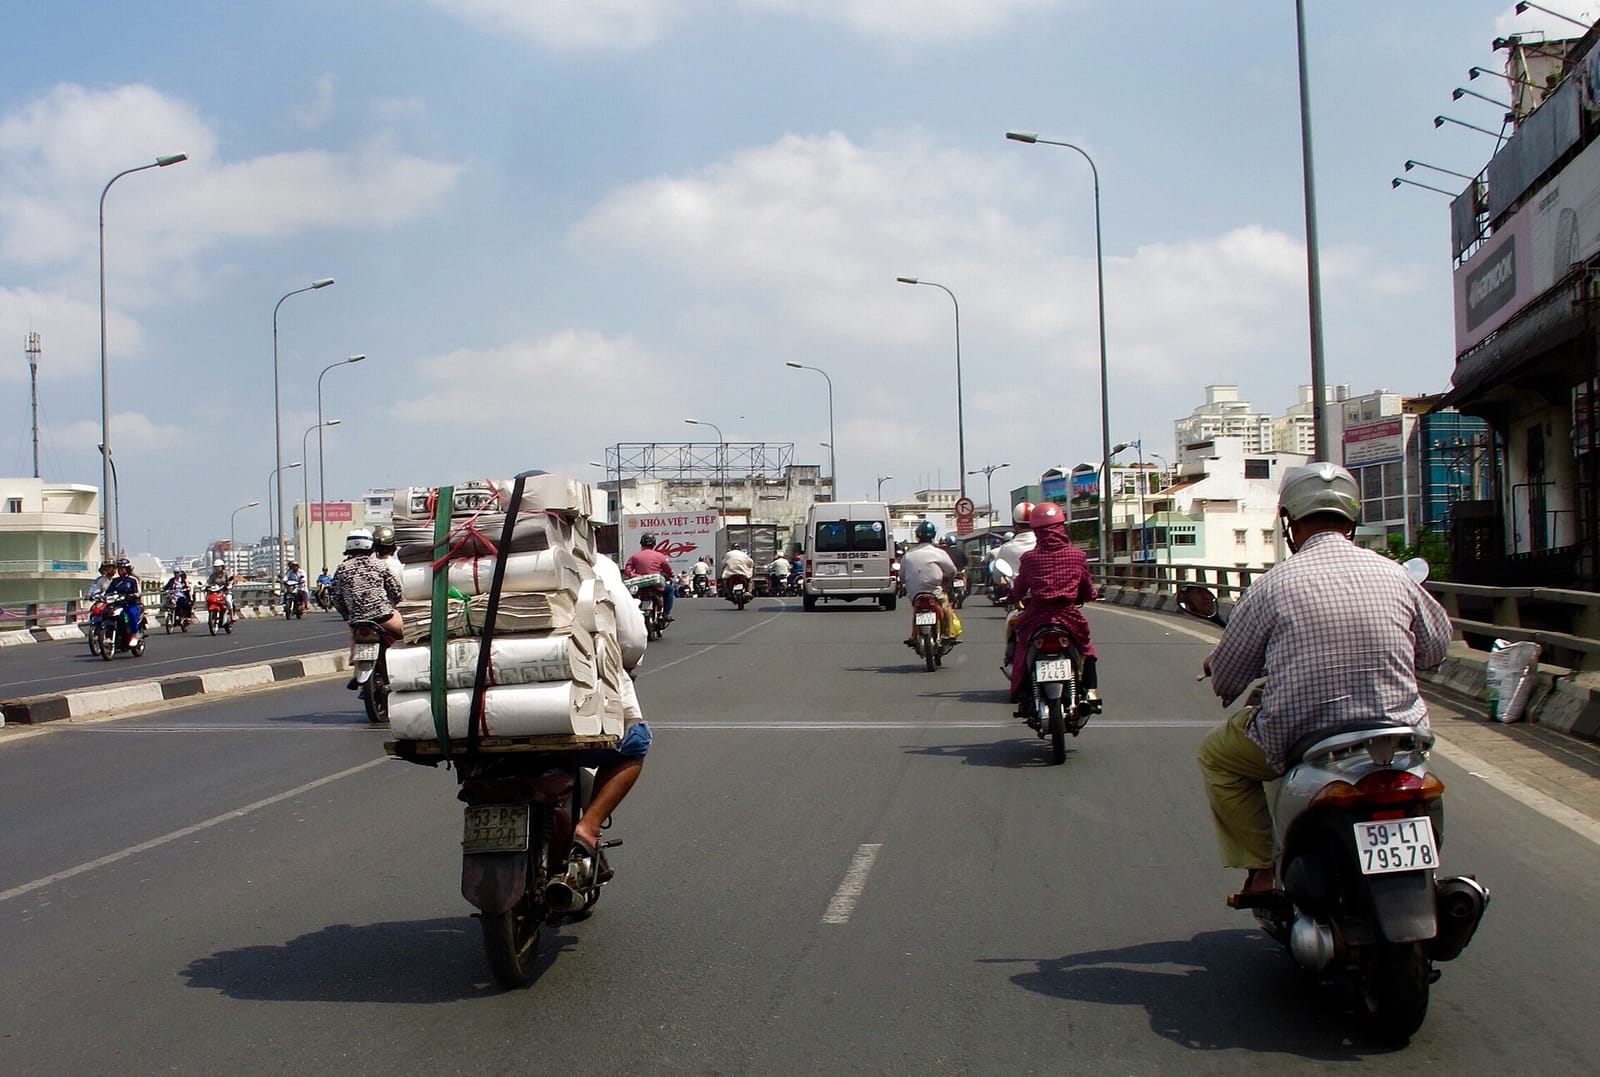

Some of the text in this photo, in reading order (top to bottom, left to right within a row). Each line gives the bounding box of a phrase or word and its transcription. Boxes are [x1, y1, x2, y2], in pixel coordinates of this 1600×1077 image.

[640, 517, 666, 528] KHÓA
[667, 516, 688, 528] VIỆT
[696, 514, 716, 526] TIỆP
[1366, 822, 1419, 847] 59-L1
[1363, 844, 1433, 870] 795.78
